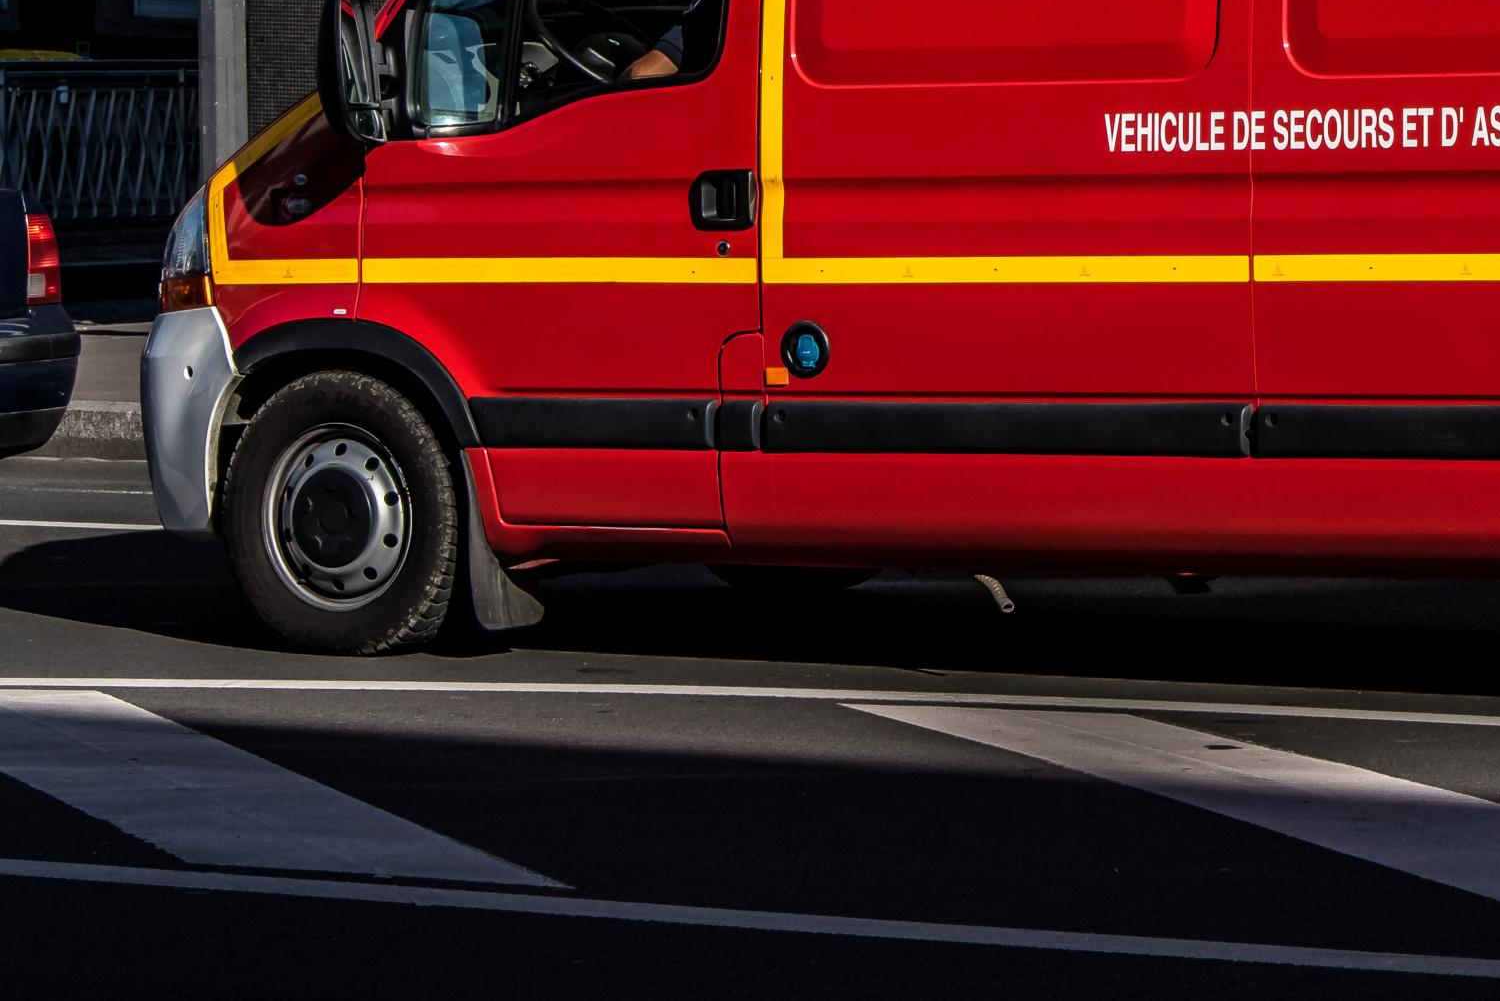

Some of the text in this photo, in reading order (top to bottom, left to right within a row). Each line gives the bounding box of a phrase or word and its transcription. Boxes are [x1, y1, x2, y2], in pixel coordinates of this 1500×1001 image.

[1104, 111, 1226, 153] VEHICULE
[1233, 110, 1266, 151] DE
[1272, 107, 1395, 151] SECOURS
[1402, 107, 1434, 148] ET
